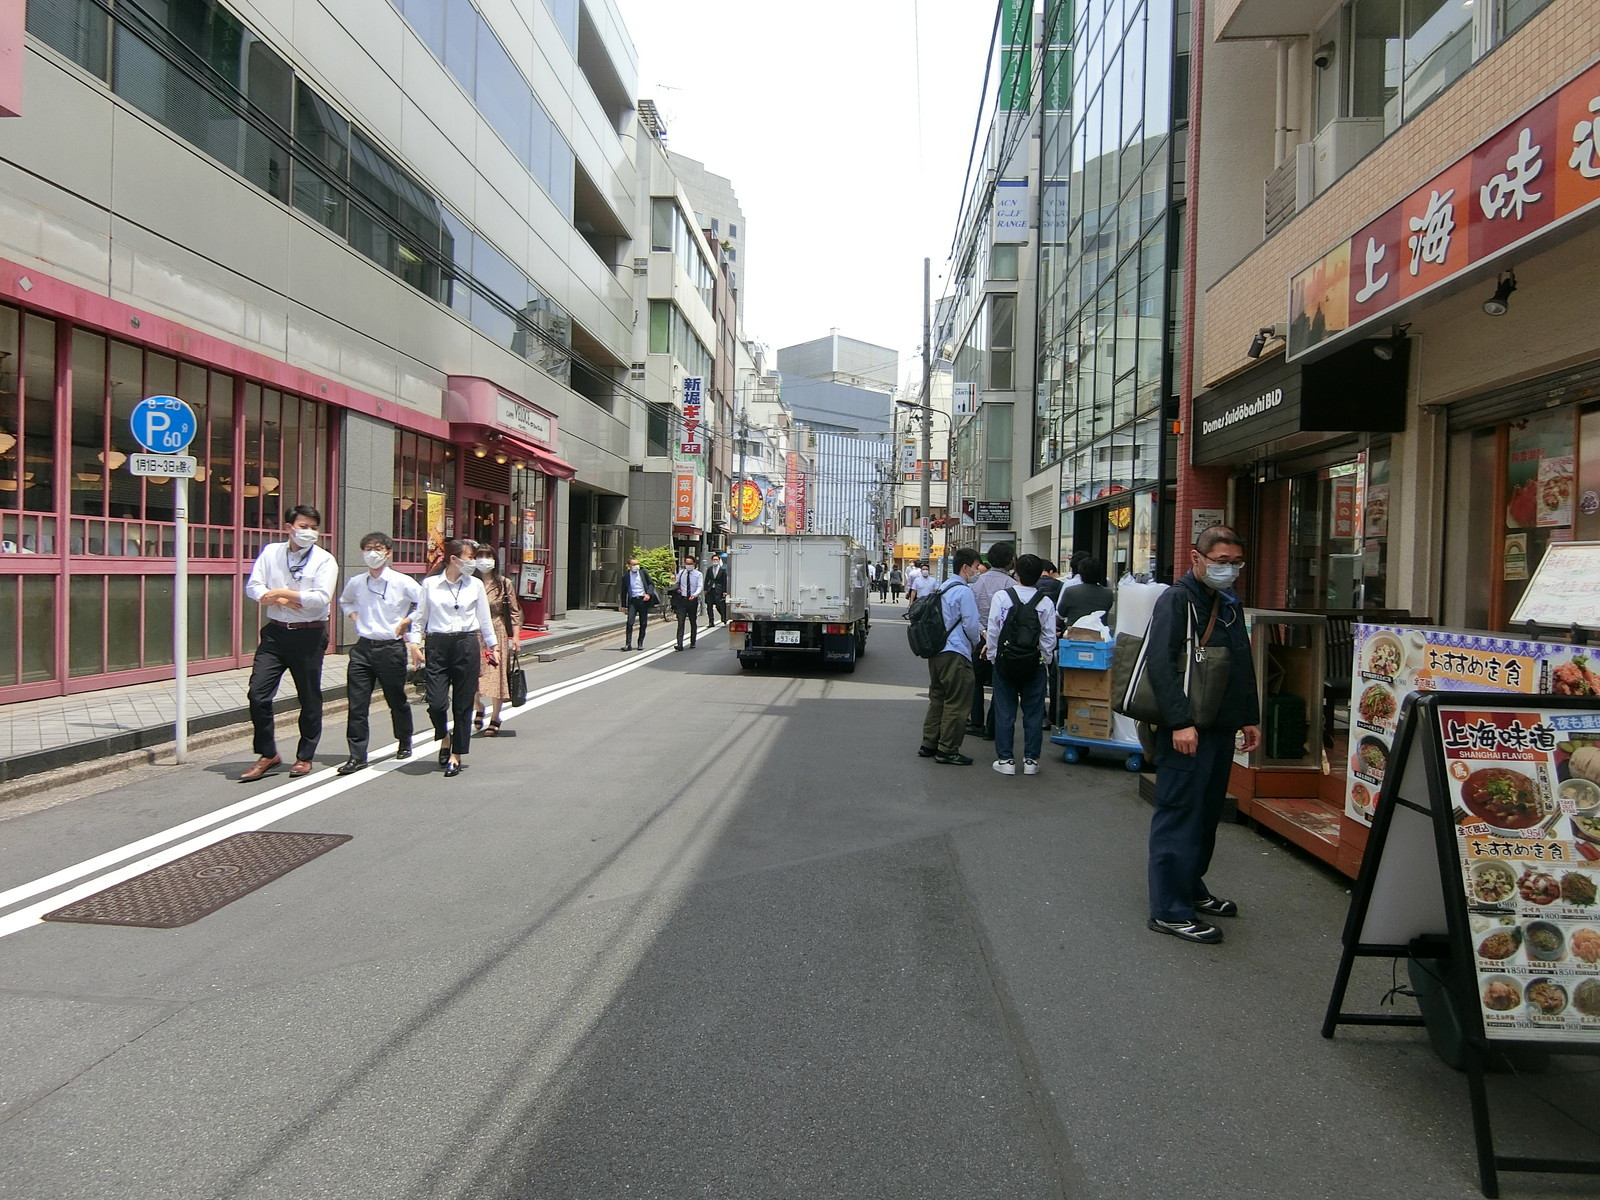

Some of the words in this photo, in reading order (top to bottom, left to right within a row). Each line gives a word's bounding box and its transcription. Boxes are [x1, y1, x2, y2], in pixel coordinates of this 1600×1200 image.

[683, 378, 701, 443] 新堀ギター
[146, 411, 171, 446] P
[181, 422, 189, 433] 分
[163, 431, 181, 447] 60
[1429, 650, 1522, 686] おすすめ定食
[1446, 719, 1556, 752] 上海味道
[1459, 751, 1500, 759] SHANGHAI
[1502, 752, 1534, 760] FLAVOR
[1457, 823, 1490, 836] 全て税込
[1472, 841, 1564, 860] おすすめ定食
